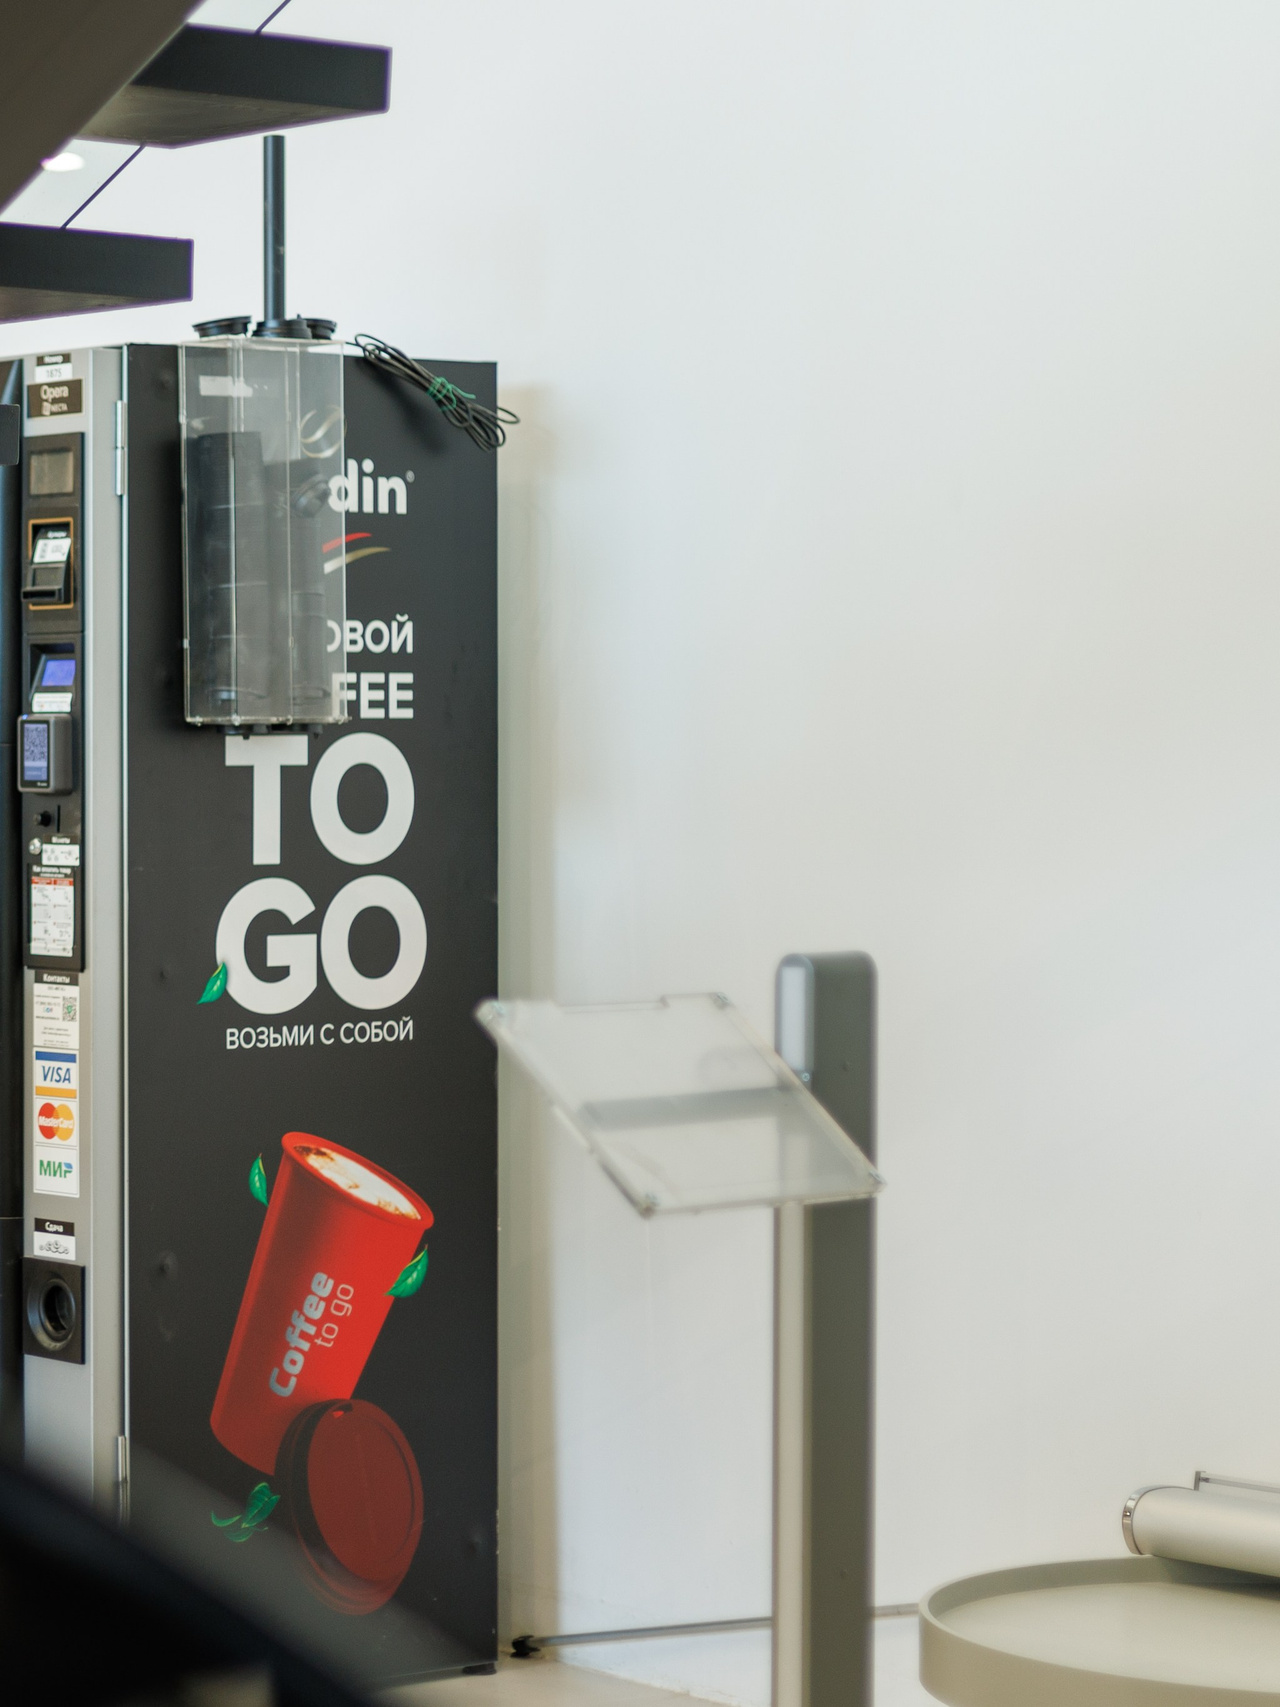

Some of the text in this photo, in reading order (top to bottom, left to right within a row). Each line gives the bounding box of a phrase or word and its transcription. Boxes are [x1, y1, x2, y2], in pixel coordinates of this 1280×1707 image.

[40, 385, 69, 402] Opera
[328, 458, 407, 514] din
[331, 672, 413, 719] FEE
[225, 732, 415, 865] TO
[216, 874, 427, 1014] GO
[43, 973, 71, 984] Контакты
[226, 1016, 414, 1050] ВОЗЬМИ С СОБОЙ
[42, 1065, 71, 1084] VISA
[38, 1115, 75, 1129] MasterCard
[39, 1159, 73, 1178] МИР
[268, 1272, 335, 1398] Coffee
[314, 1284, 354, 1348] to go
